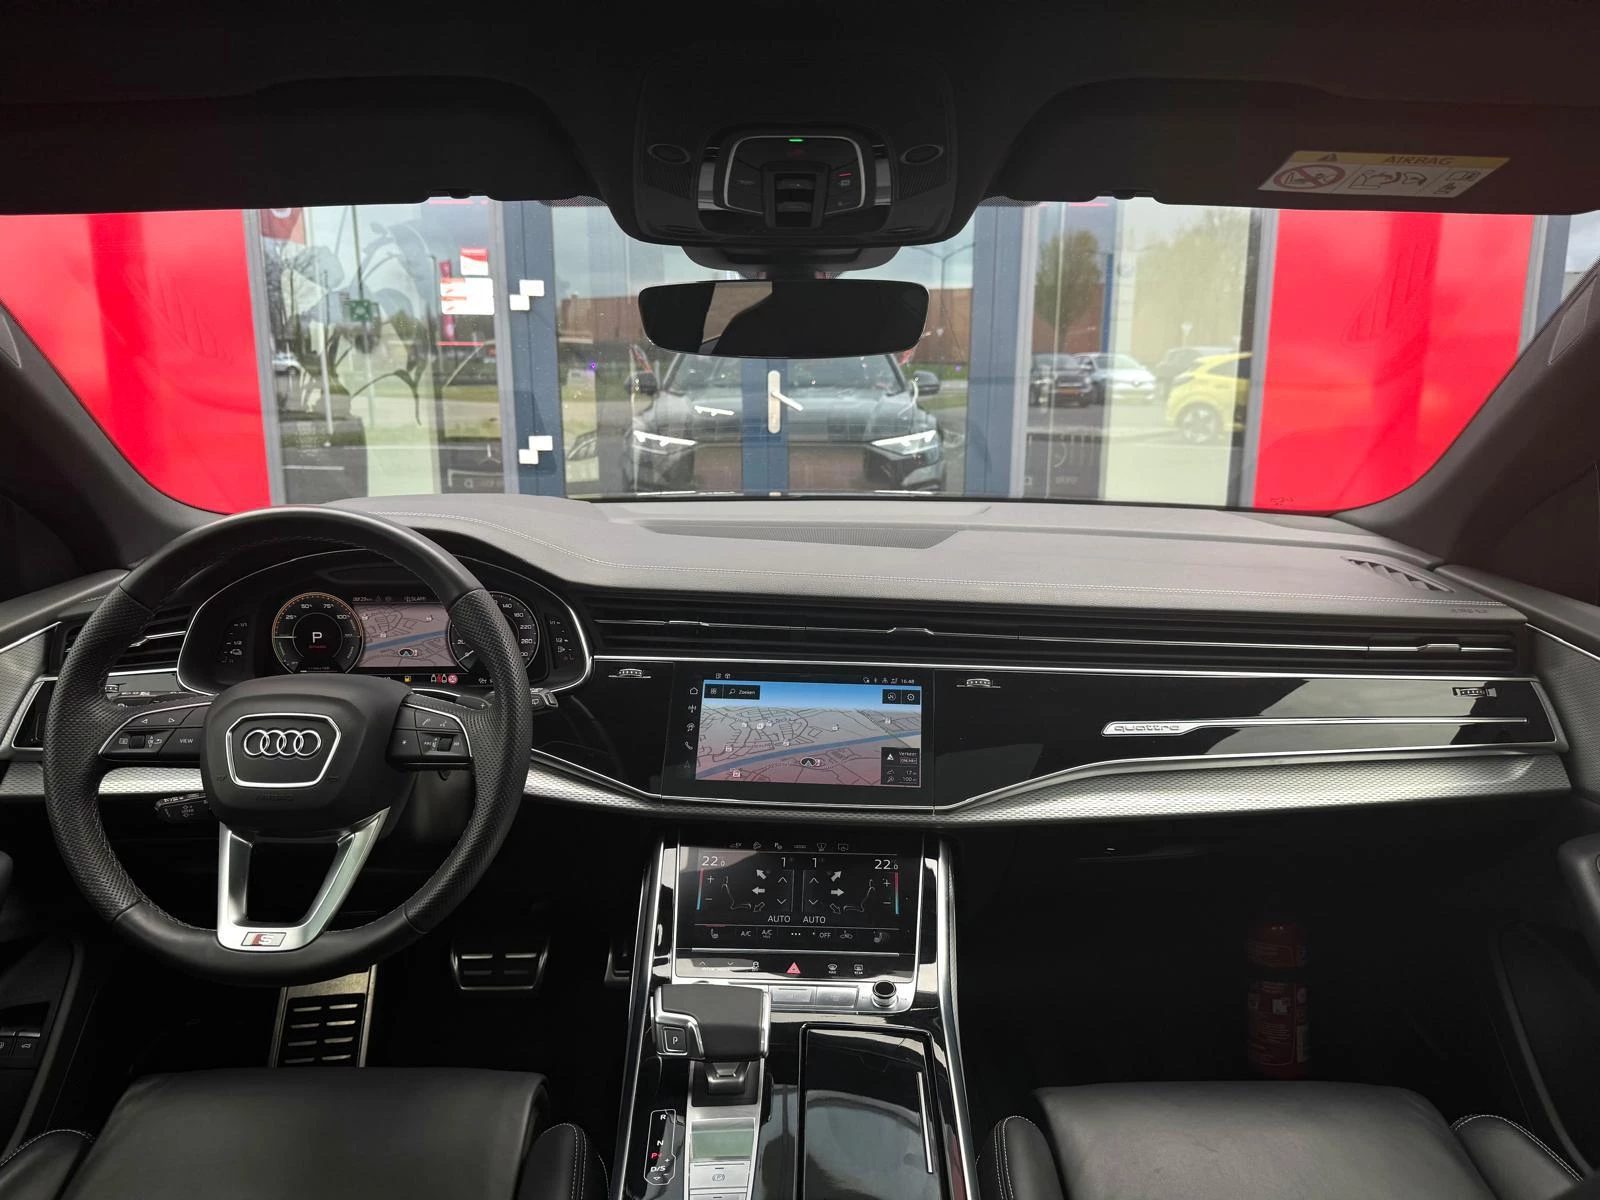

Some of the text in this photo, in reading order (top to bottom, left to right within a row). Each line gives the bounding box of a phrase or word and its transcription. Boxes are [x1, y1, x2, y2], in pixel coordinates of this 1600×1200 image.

[1383, 155, 1453, 167] AIRBAG
[312, 632, 323, 644] P
[1113, 724, 1181, 733] quattro
[767, 915, 791, 923] AUTO
[802, 915, 826, 924] AUTO
[672, 1036, 679, 1045] P
[659, 1113, 667, 1121] R
[656, 1139, 664, 1147] N
